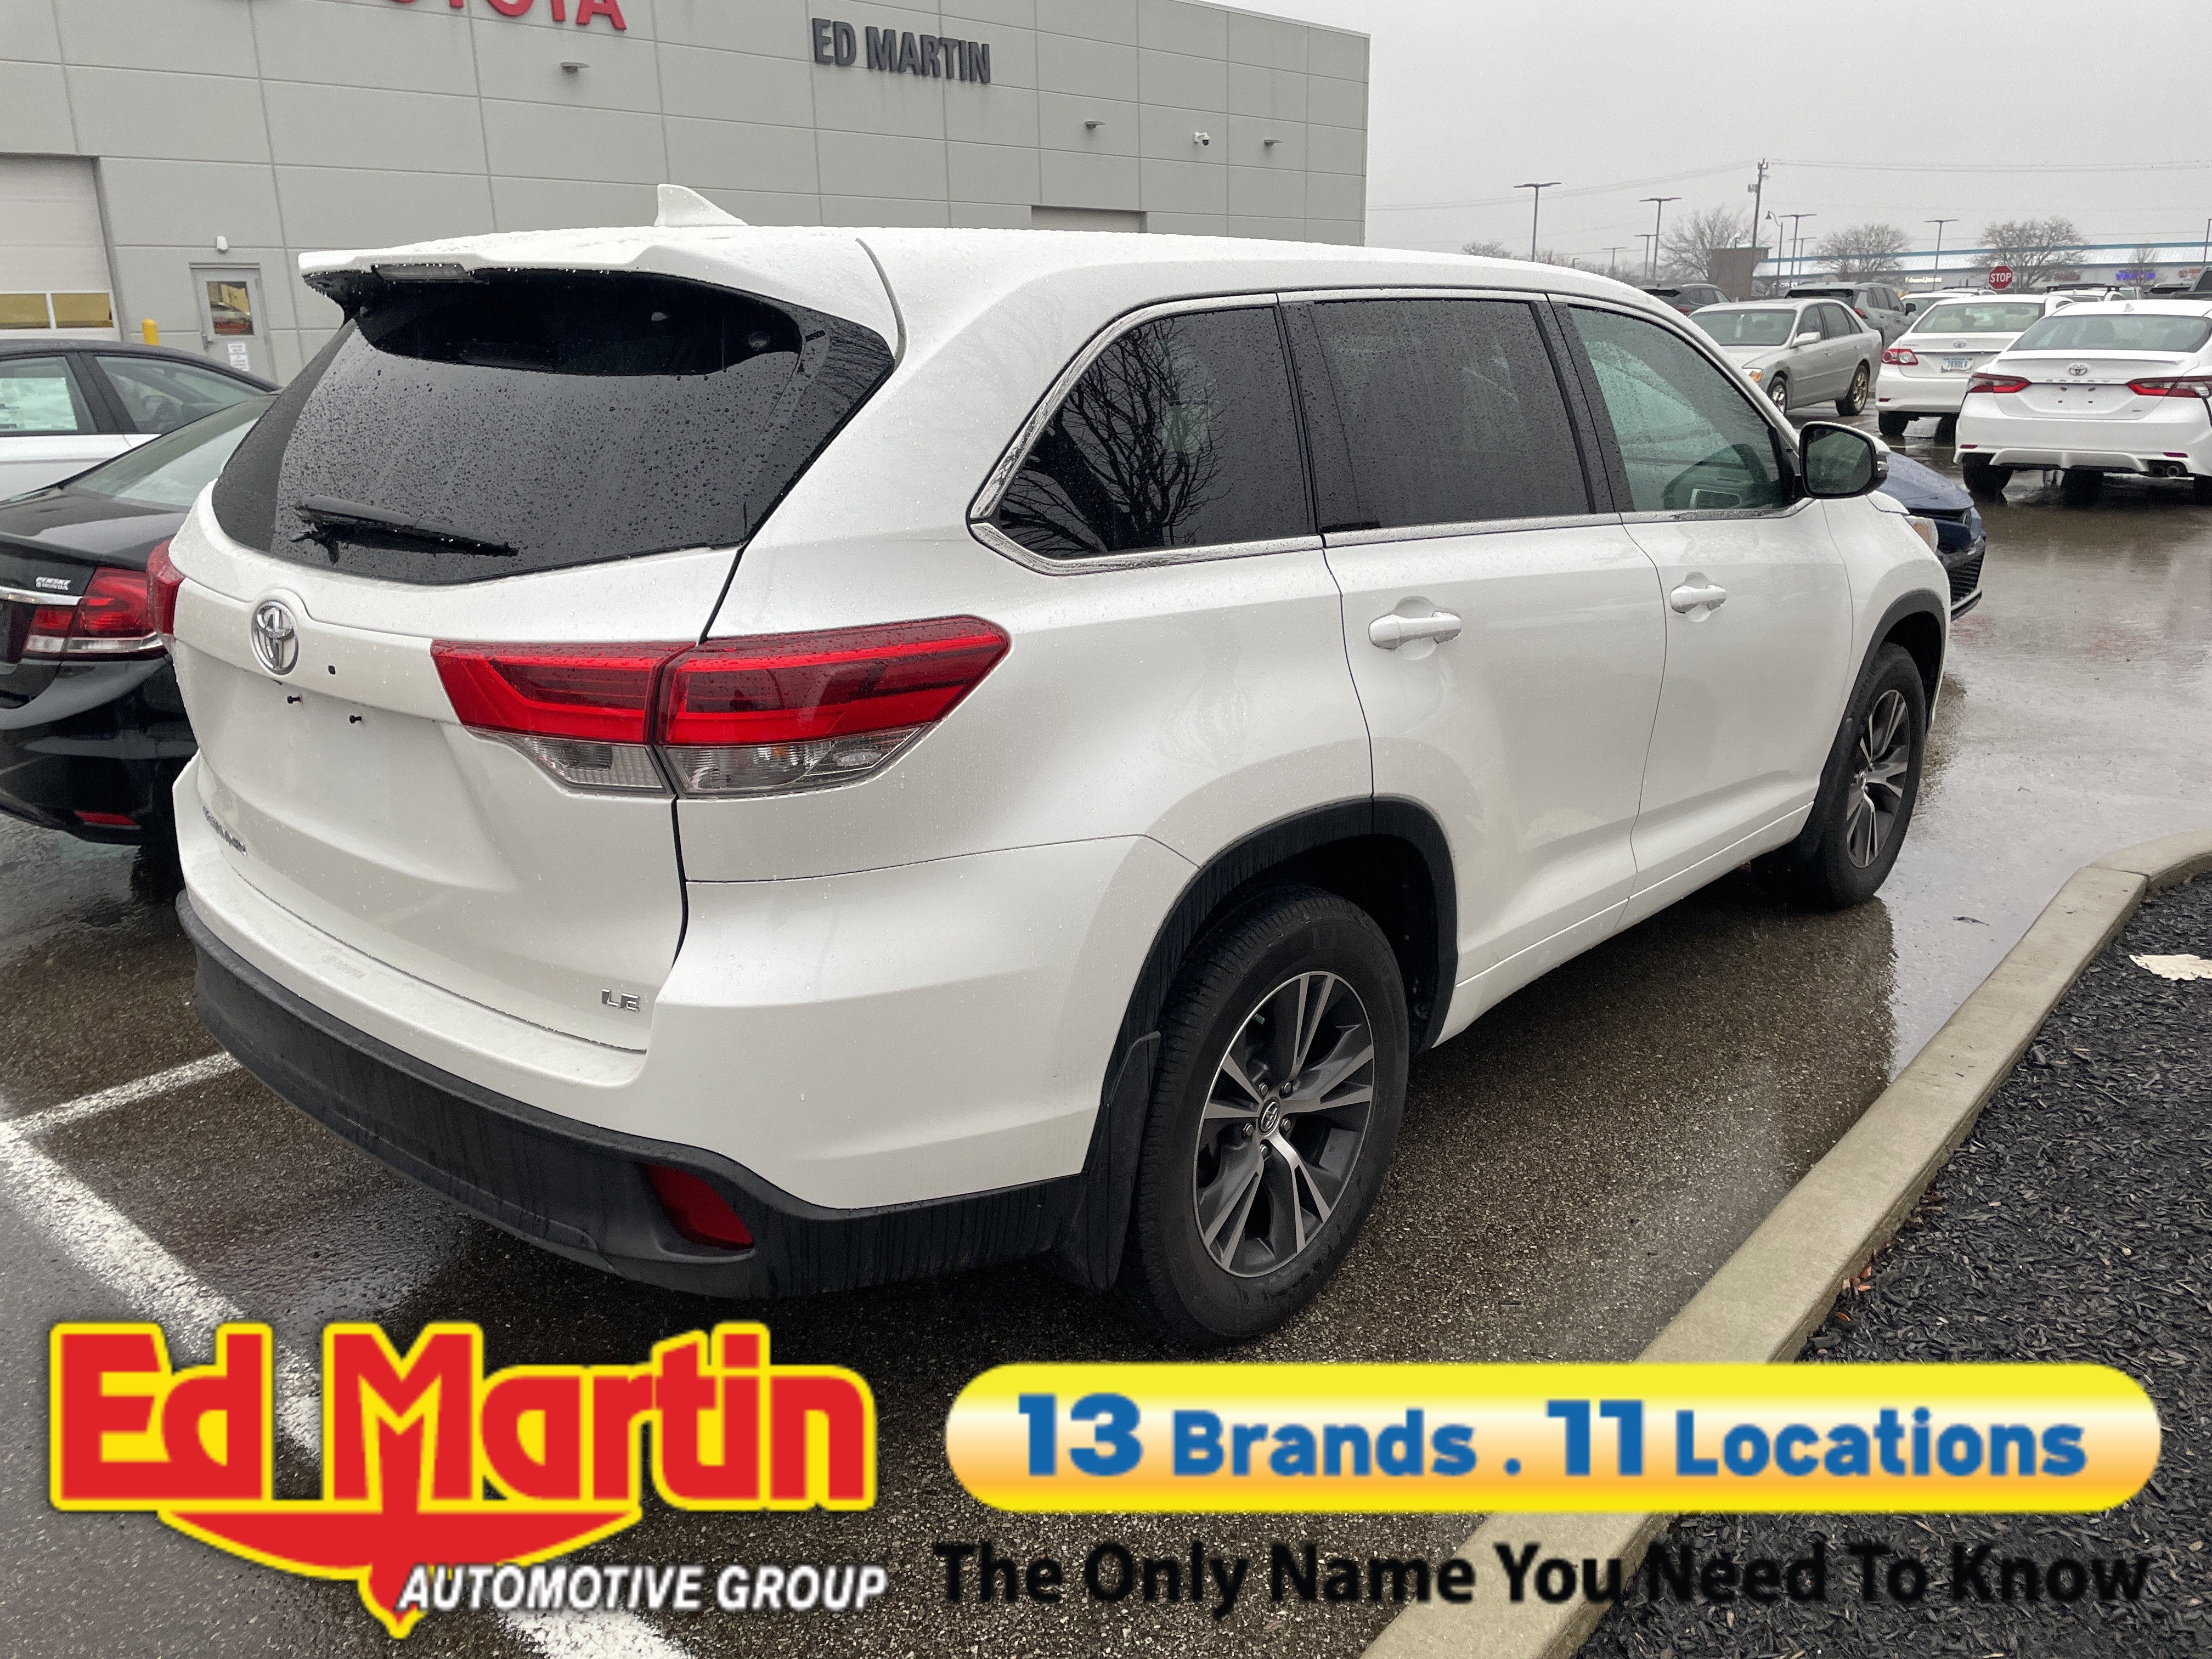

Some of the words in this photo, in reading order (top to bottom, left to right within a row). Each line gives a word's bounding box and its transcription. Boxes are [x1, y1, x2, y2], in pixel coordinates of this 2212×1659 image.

[812, 18, 856, 65] ED
[865, 26, 990, 84] MARTIN
[1990, 272, 2012, 283] STOP
[601, 988, 640, 1012] LE
